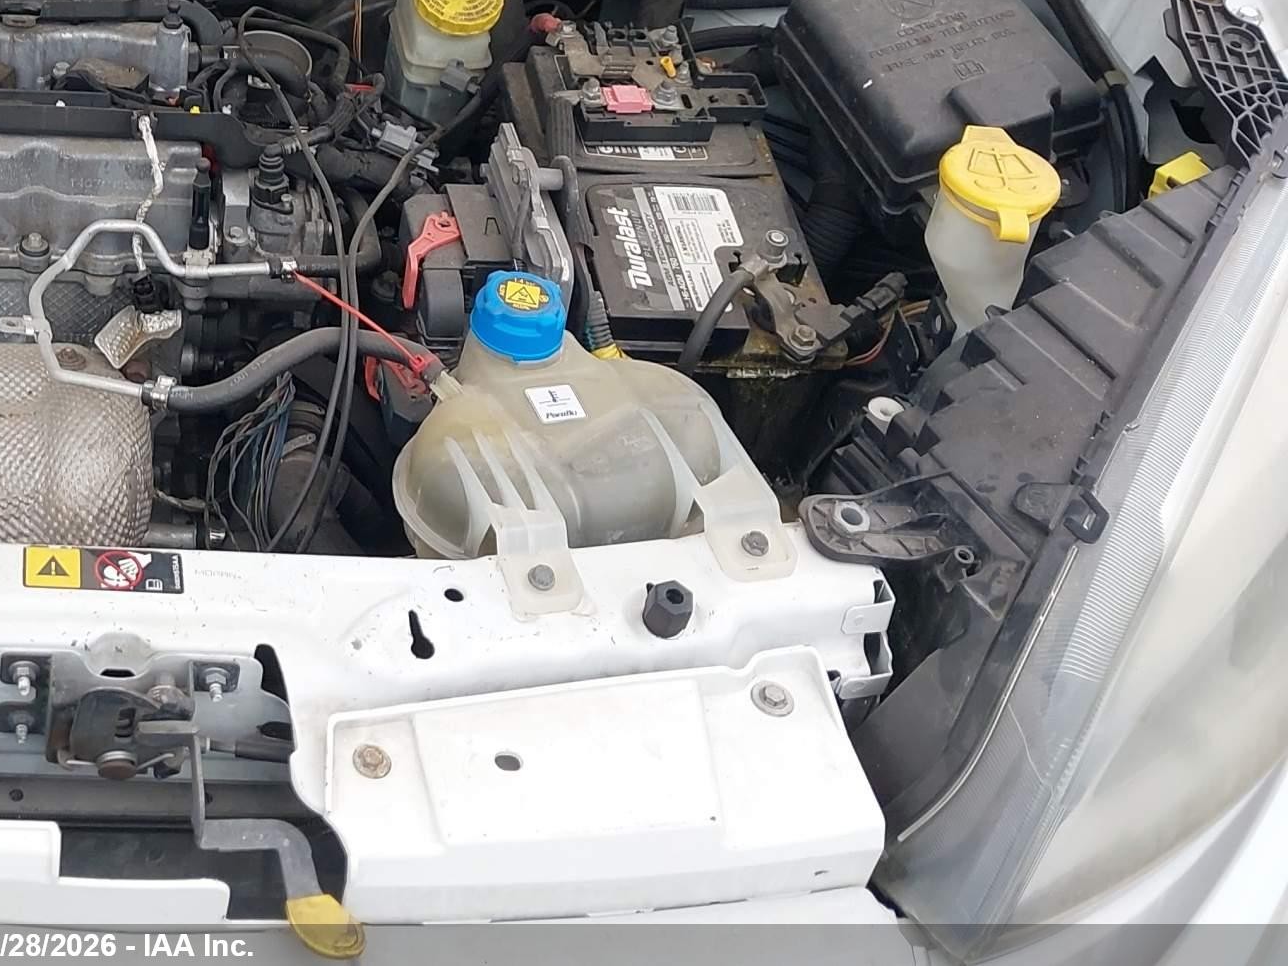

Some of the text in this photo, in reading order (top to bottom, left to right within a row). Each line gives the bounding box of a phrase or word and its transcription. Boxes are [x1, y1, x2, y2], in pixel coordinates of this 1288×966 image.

[607, 206, 653, 289] Duralast
[629, 209, 653, 258] PLATINUM
[643, 212, 669, 266] TECHNOLOGY
